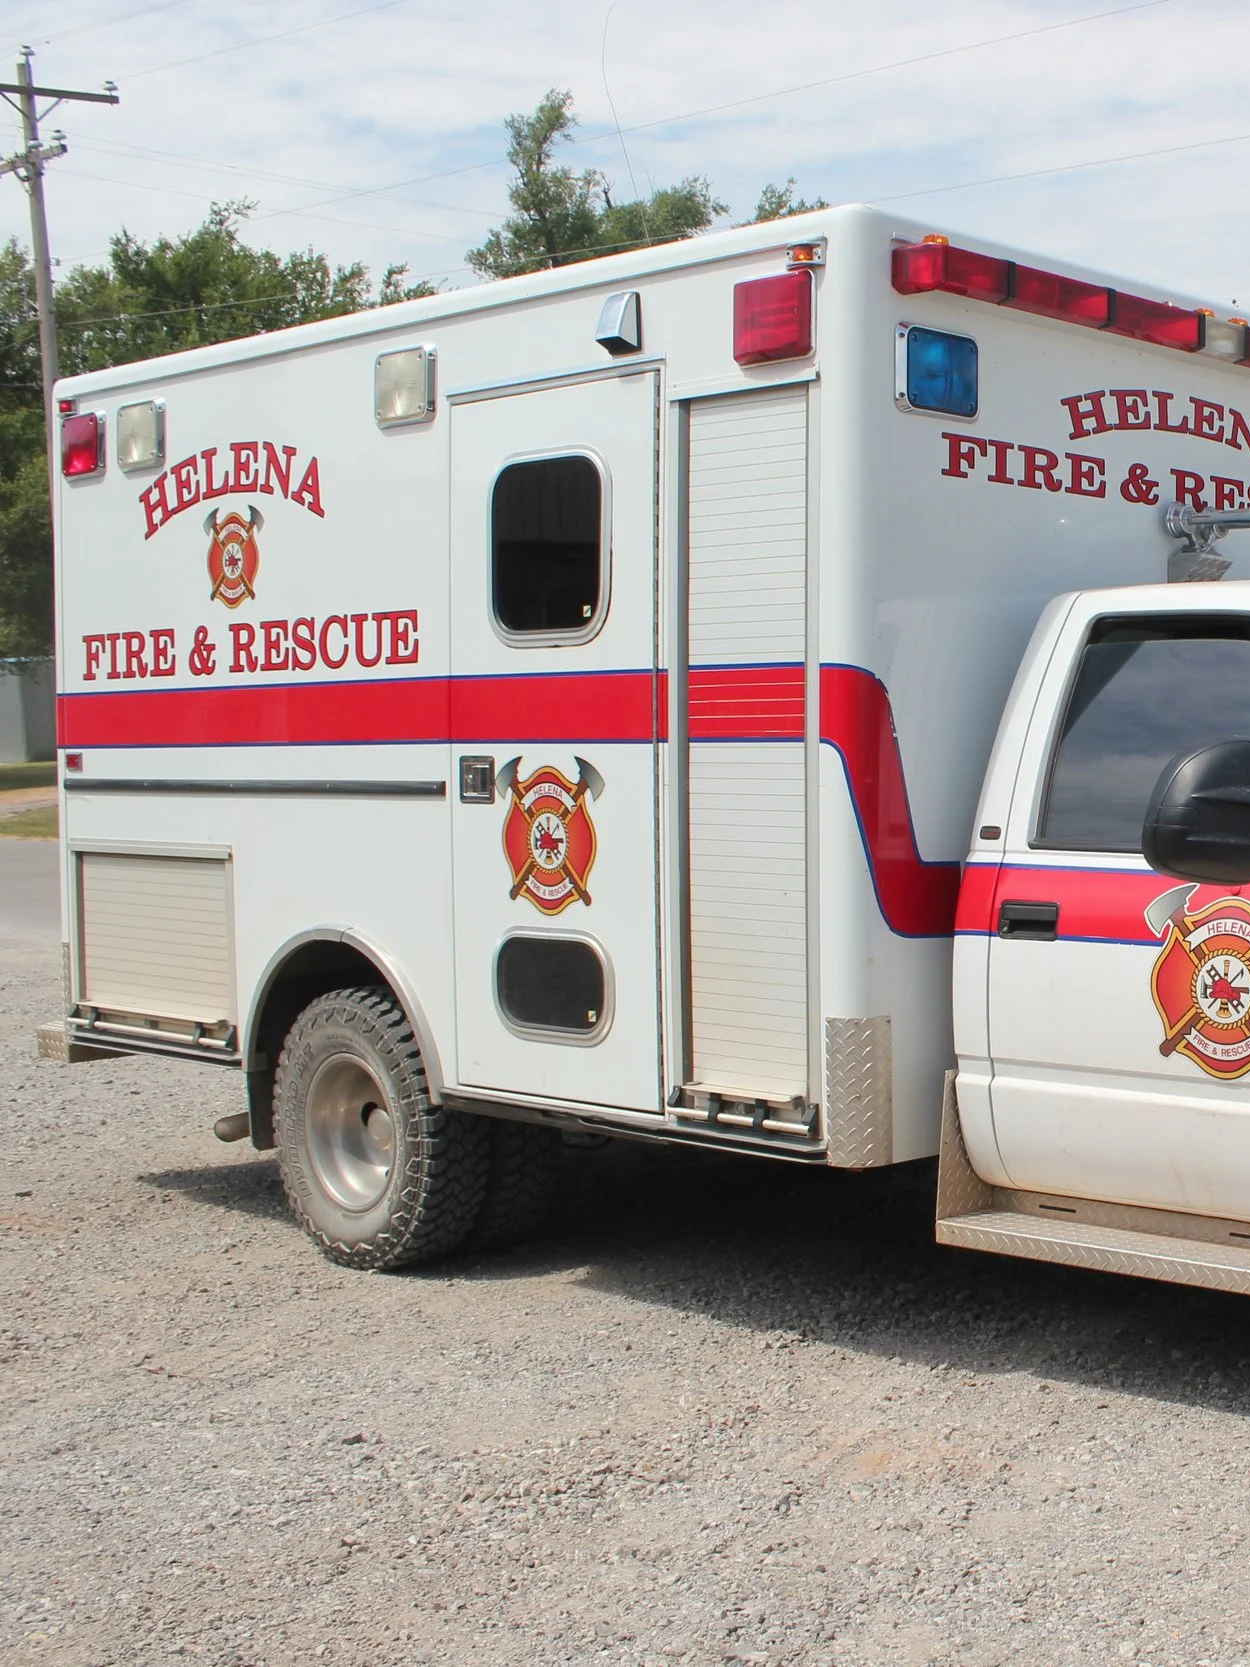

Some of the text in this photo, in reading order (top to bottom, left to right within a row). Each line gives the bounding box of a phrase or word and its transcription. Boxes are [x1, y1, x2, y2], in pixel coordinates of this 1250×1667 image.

[139, 440, 325, 540] HELENA
[941, 432, 1106, 499] FIRE
[1120, 463, 1159, 506] &
[82, 609, 419, 681] FIRE & RESCUE
[533, 785, 563, 799] HELENA
[1193, 1034, 1210, 1052] FIRE
[1212, 1046, 1218, 1056] &
